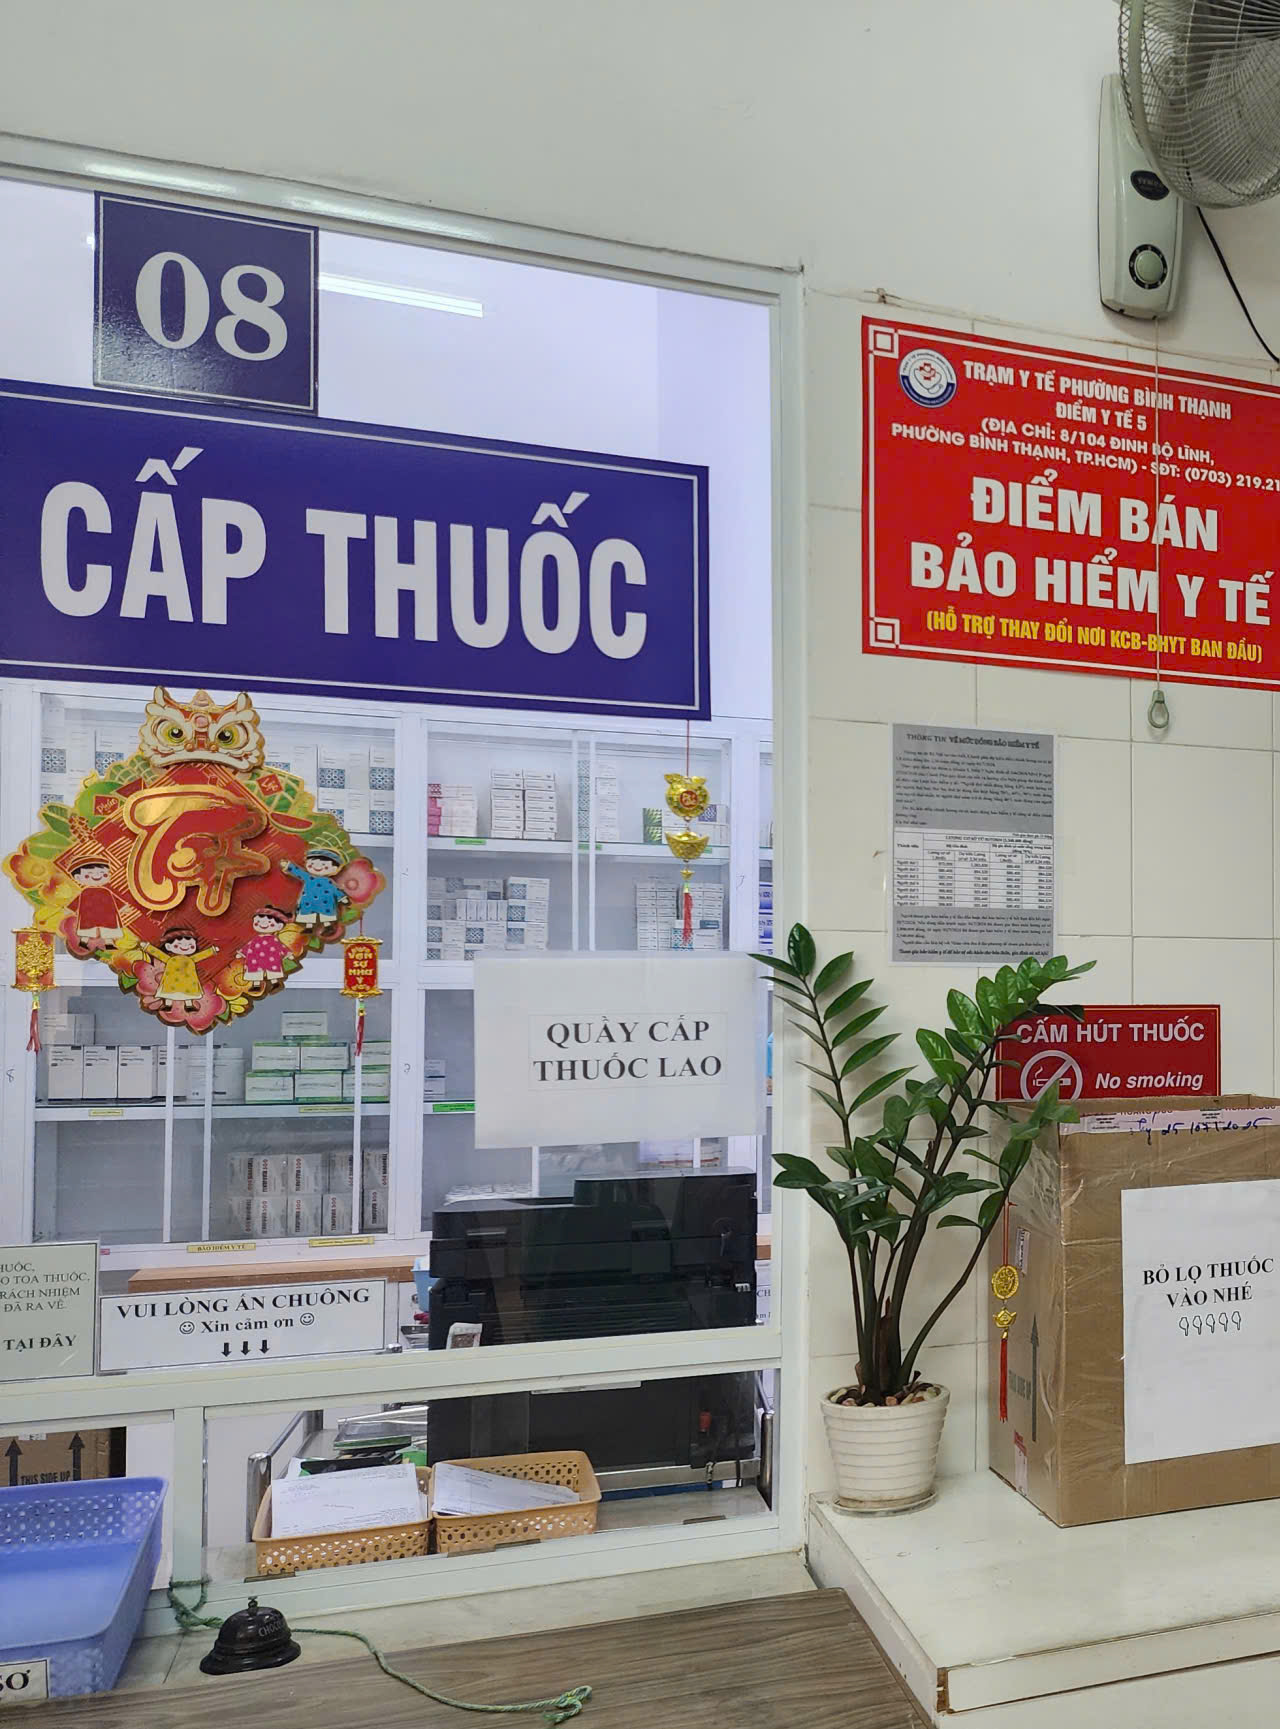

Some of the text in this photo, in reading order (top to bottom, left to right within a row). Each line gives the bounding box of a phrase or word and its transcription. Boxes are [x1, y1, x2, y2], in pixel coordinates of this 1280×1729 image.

[136, 251, 287, 362] 08
[963, 360, 1014, 386] TRẠM
[1018, 370, 1030, 388] Y
[1034, 369, 1055, 392] TẾ
[1059, 376, 1129, 404] PHƯỜNG
[1134, 386, 1174, 411] BÌNH
[1178, 395, 1231, 420] THẠNH
[1056, 400, 1147, 431] ĐIỂM Y TẾ 5
[892, 423, 965, 446] PHƯỜNG
[969, 432, 1008, 453] BÌNH
[1012, 440, 1071, 464] THẠNH,
[1074, 450, 1137, 475] TP.HCM)
[1150, 462, 1181, 478] SĐT:
[1185, 467, 1232, 488] (0703)
[981, 417, 1215, 466] (ĐỊA CHỈ: 8/104 ĐINH BỘ LĨNH,
[970, 468, 1218, 552] ĐIỂM BÁN
[40, 447, 647, 660] CẤP THUỐC
[910, 532, 1274, 626] BẢO HIỂM Y TẾ
[927, 605, 1263, 663] (HỖ TRỢ THAY ĐỔI NƠI KCB-BHYT BAN ĐẦU)
[546, 1014, 710, 1049] QUẦY CẤP
[1016, 1015, 1204, 1043] CẤM HÚT THUỐC
[533, 1052, 722, 1082] THUỐC LAO
[1095, 1071, 1204, 1091] No smoking
[14, 1275, 39, 1285] TOA
[1143, 1255, 1275, 1288] BỎ LỌ THUỐC
[26, 1302, 43, 1311] RA
[39, 1287, 80, 1298] NHIỆM
[117, 1287, 370, 1319] VUI LÒNG ẤN CHUÔNG
[1166, 1284, 1252, 1308] VÀO NHÉ
[201, 1317, 294, 1333] Xin cảm ơn
[4, 1333, 77, 1353] TẠI ĐÂY
